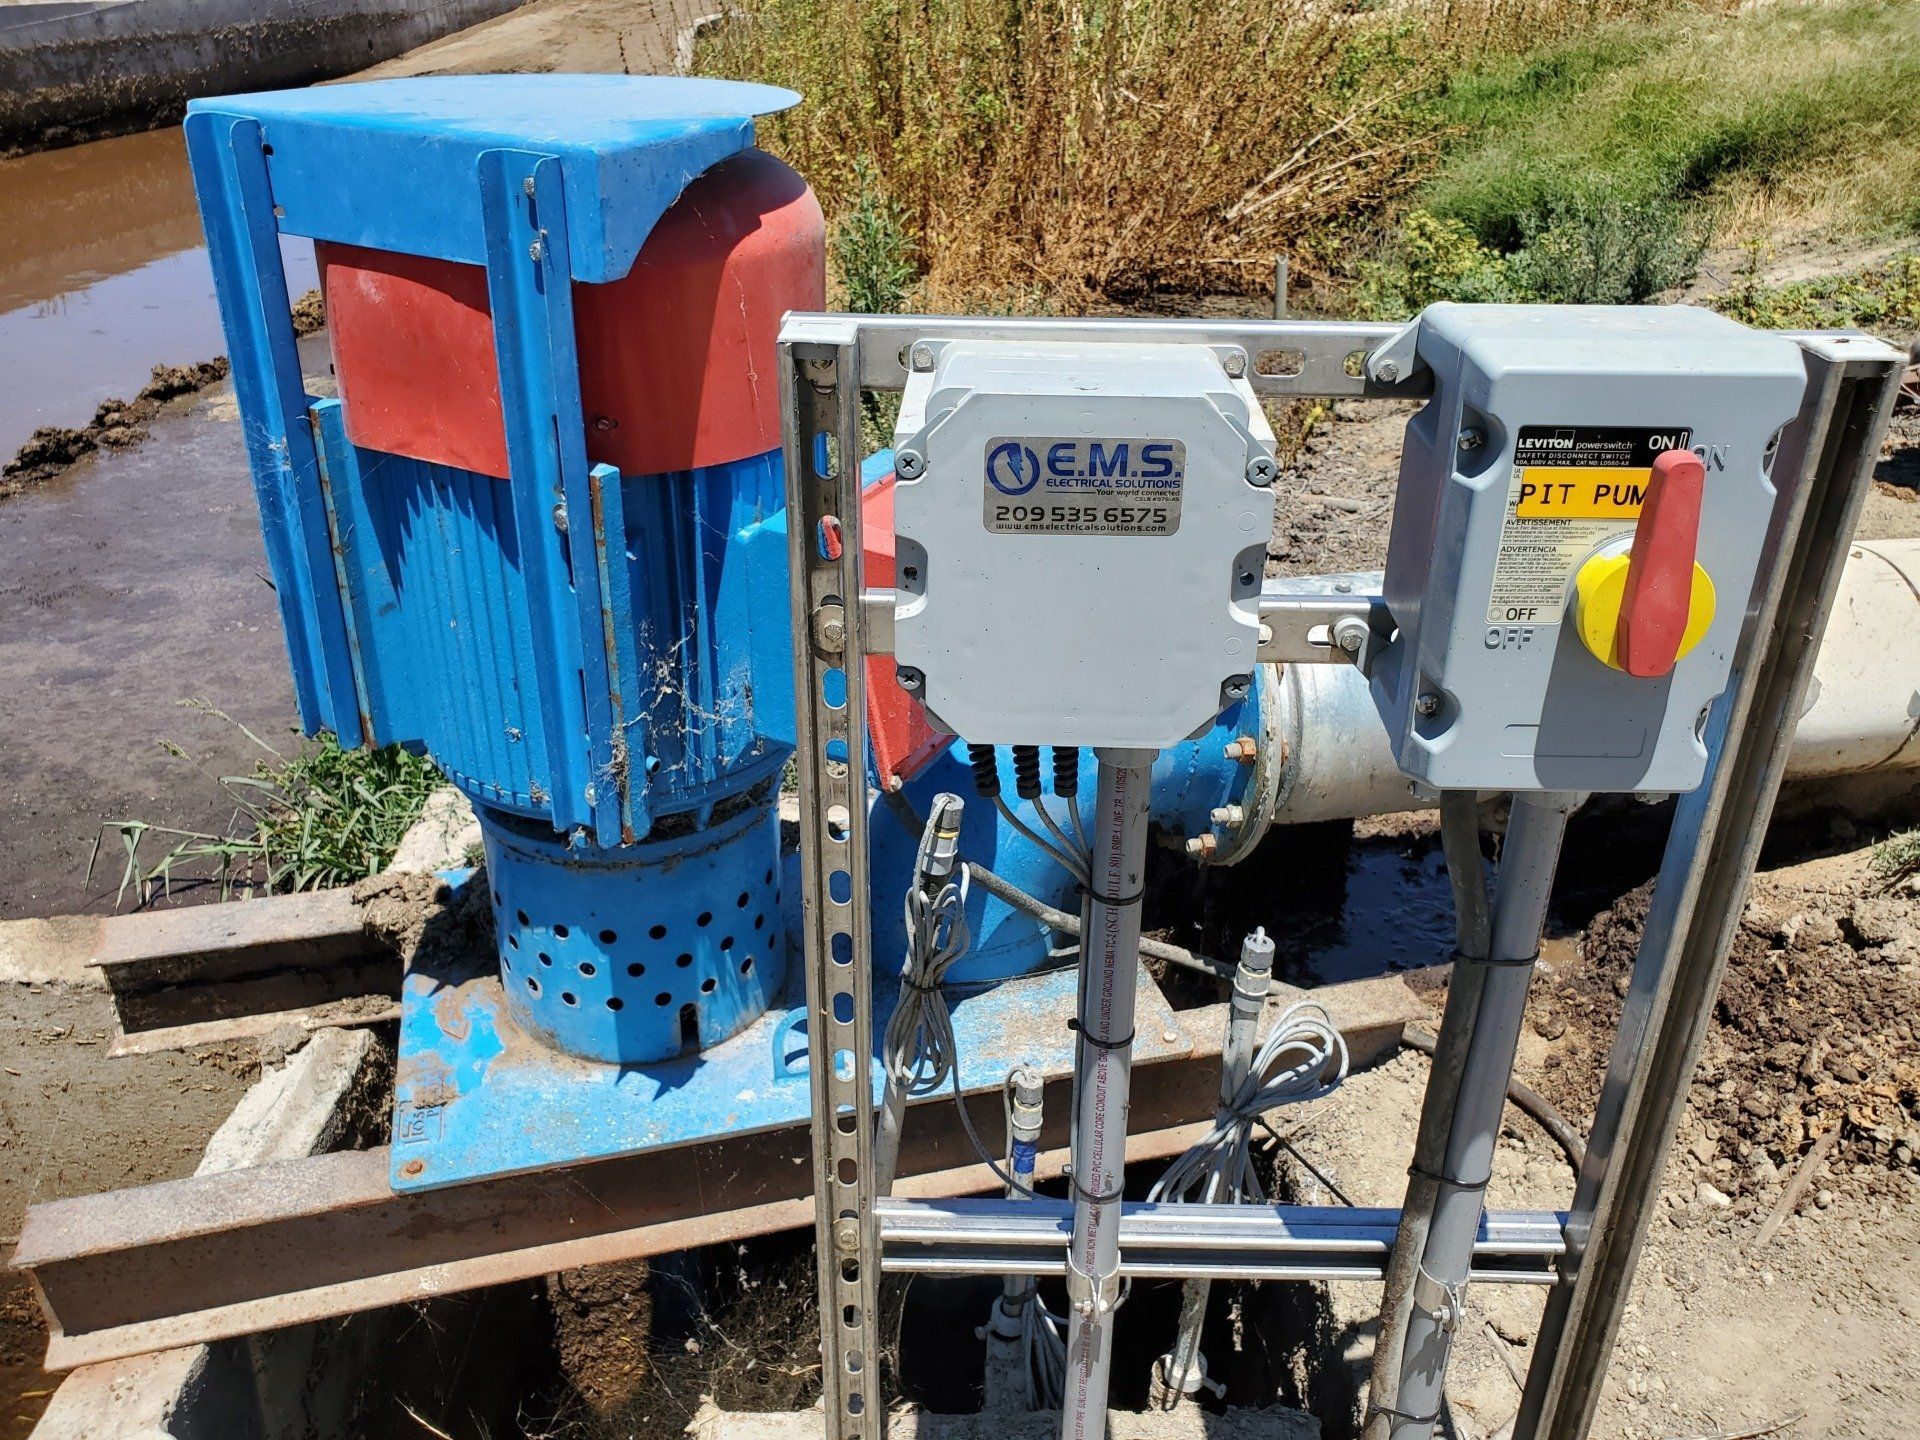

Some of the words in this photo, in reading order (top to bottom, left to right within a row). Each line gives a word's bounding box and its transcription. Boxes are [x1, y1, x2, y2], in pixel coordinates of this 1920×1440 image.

[1518, 438, 1574, 449] LEVITON
[1576, 442, 1632, 450] powerswitch
[1648, 435, 1676, 450] ON
[1047, 443, 1181, 478] E.M.S.
[1046, 479, 1112, 488] ELECTRICAL
[1116, 480, 1181, 489] SOLUTIONS
[1520, 484, 1576, 504] PIT
[1593, 485, 1647, 506] PUM
[996, 506, 1045, 522] 209
[1050, 507, 1098, 522] 535
[1103, 508, 1168, 524] 6575
[996, 524, 1167, 532] www.emselectricalsolutions.com
[1506, 608, 1538, 620] OFF
[1485, 627, 1535, 650] OFF
[1105, 870, 1121, 933] (SCHDULE
[1104, 950, 1115, 968] NEMA
[1102, 970, 1114, 997] GROUND
[1100, 998, 1112, 1020] UNDER
[1100, 1021, 1110, 1034] AND
[1098, 1036, 1109, 1062] GROD
[1097, 1063, 1108, 1084] ABOVE
[1096, 1085, 1106, 1111] CONDUIT
[1094, 1112, 1105, 1129] CORE
[1093, 1129, 1104, 1160] CELLULAR
[1091, 1160, 1102, 1172] PVC
[1086, 1238, 1096, 1250] NON
[1086, 1251, 1096, 1265] RIGID
